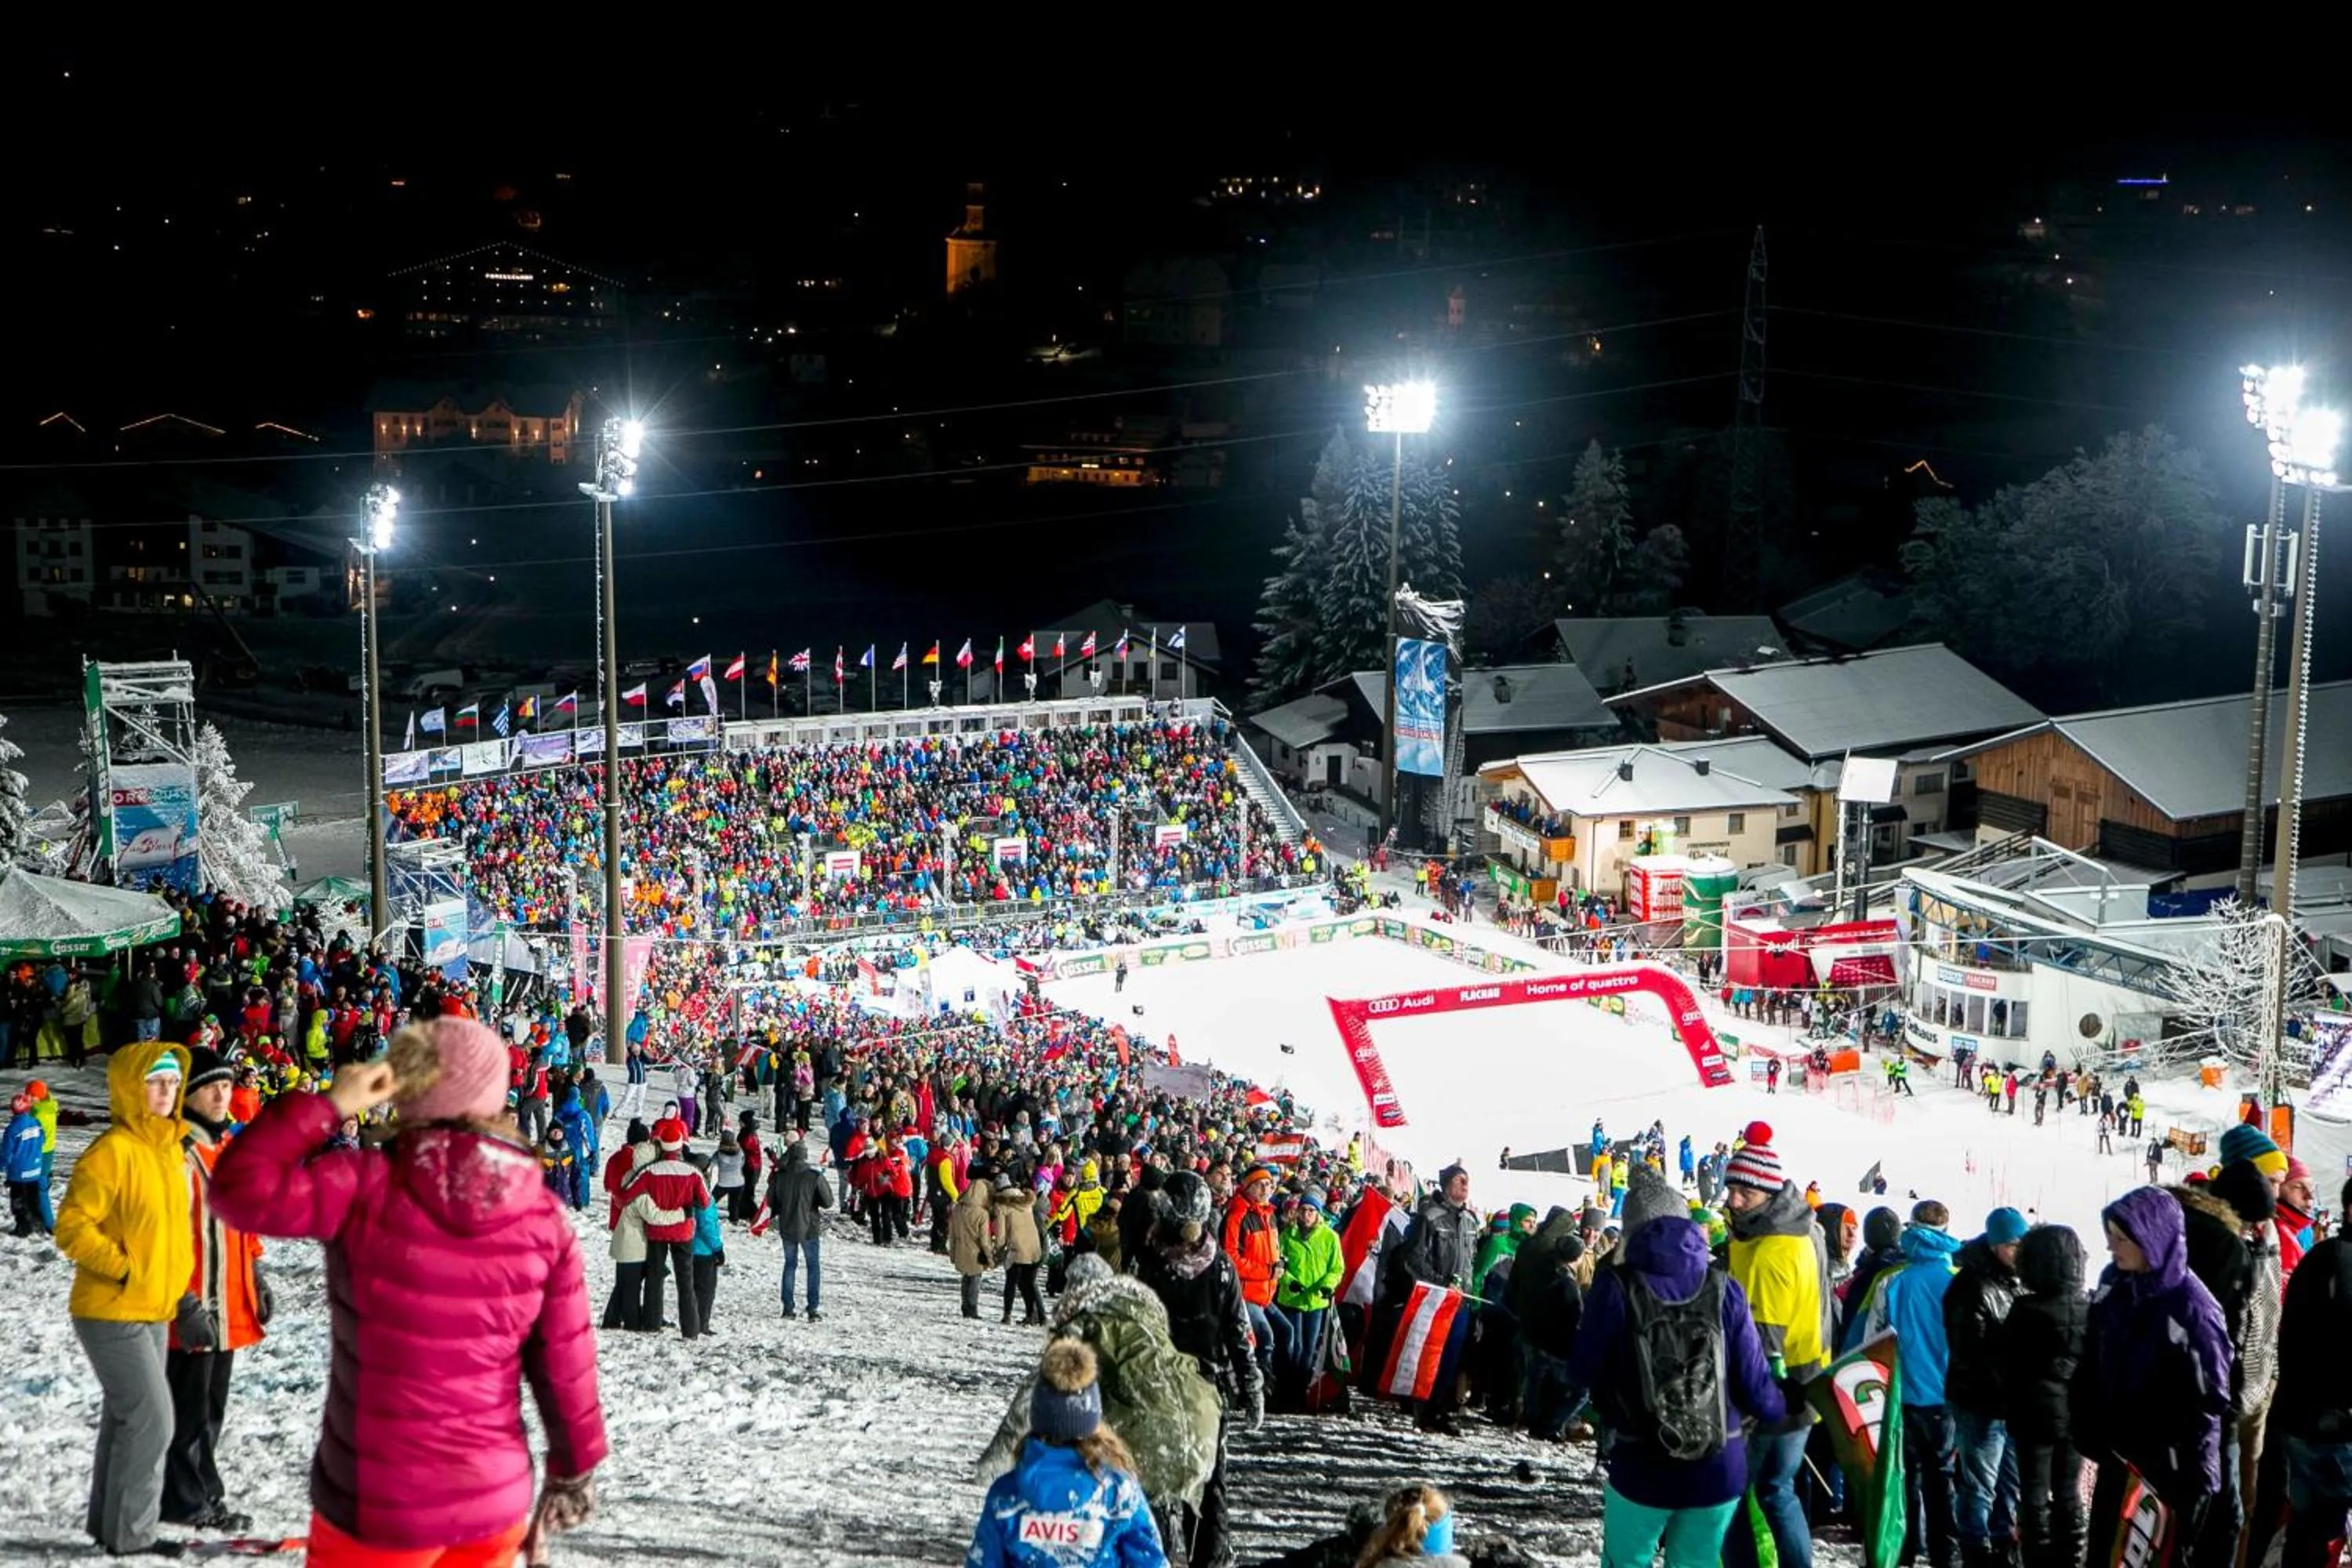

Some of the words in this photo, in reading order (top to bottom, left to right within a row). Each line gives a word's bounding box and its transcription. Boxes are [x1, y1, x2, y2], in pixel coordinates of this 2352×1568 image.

[1402, 994, 1435, 1008] Audi
[1460, 987, 1501, 1002] FLACHAU
[1526, 983, 1567, 995] Home
[1570, 978, 1584, 991] of
[1587, 975, 1639, 991] quattro
[1025, 1520, 1080, 1544] AVIS
